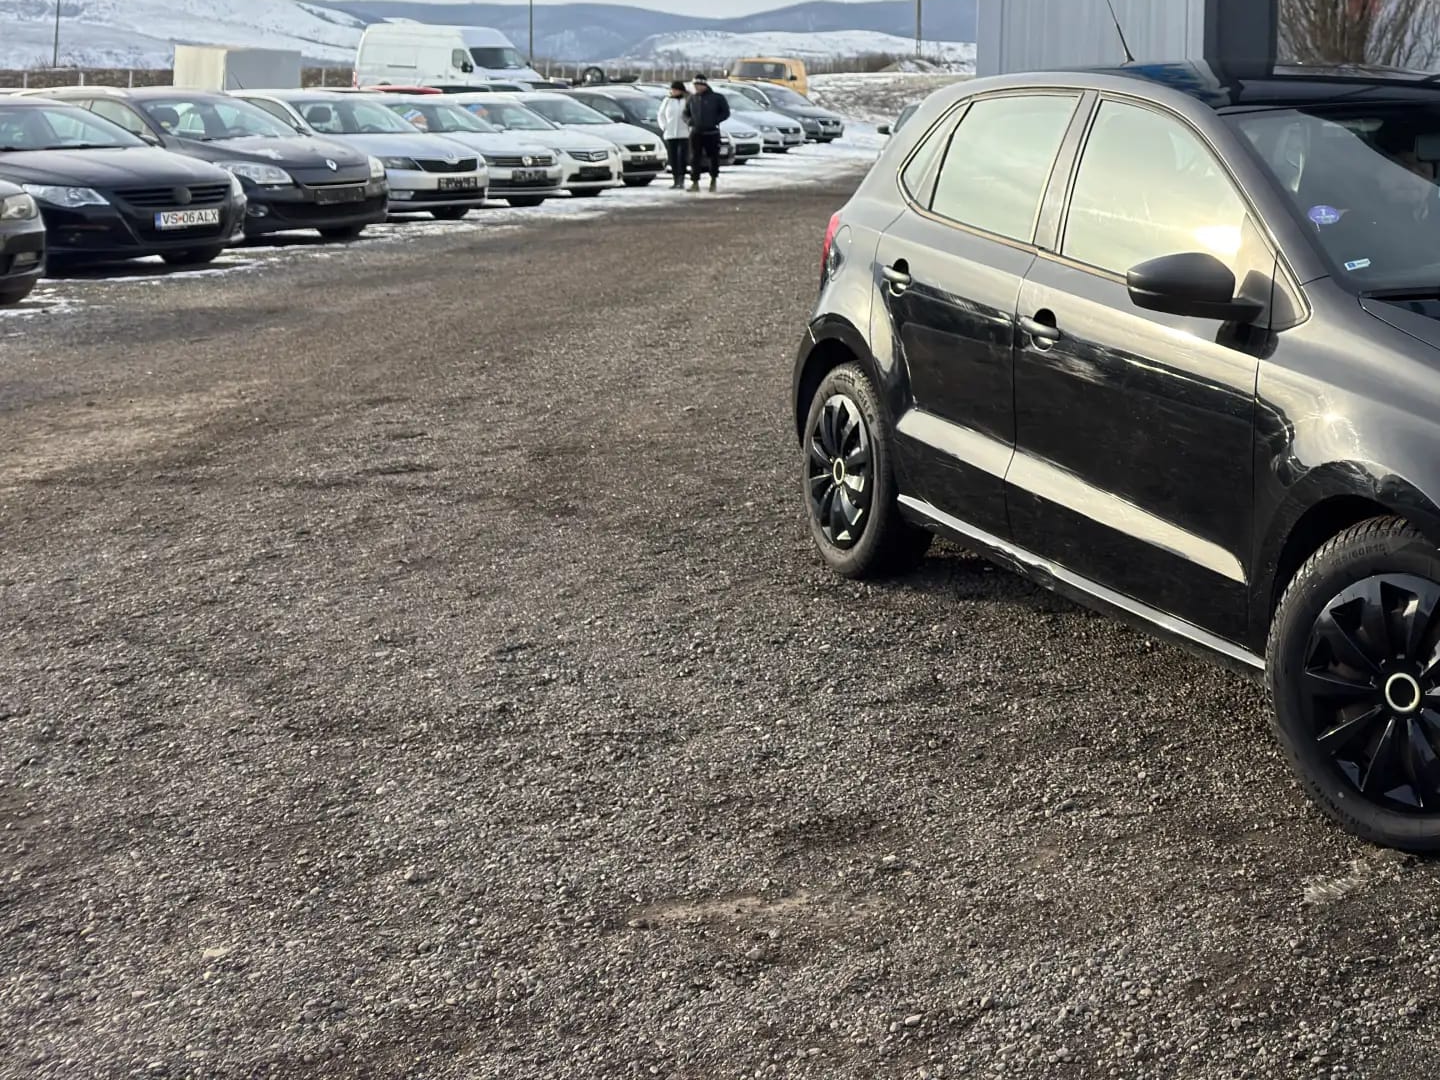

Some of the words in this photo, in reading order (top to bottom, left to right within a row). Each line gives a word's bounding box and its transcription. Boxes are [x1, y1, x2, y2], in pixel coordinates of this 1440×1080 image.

[162, 213, 178, 225] VS
[182, 212, 195, 224] 06
[196, 210, 217, 223] ALX
